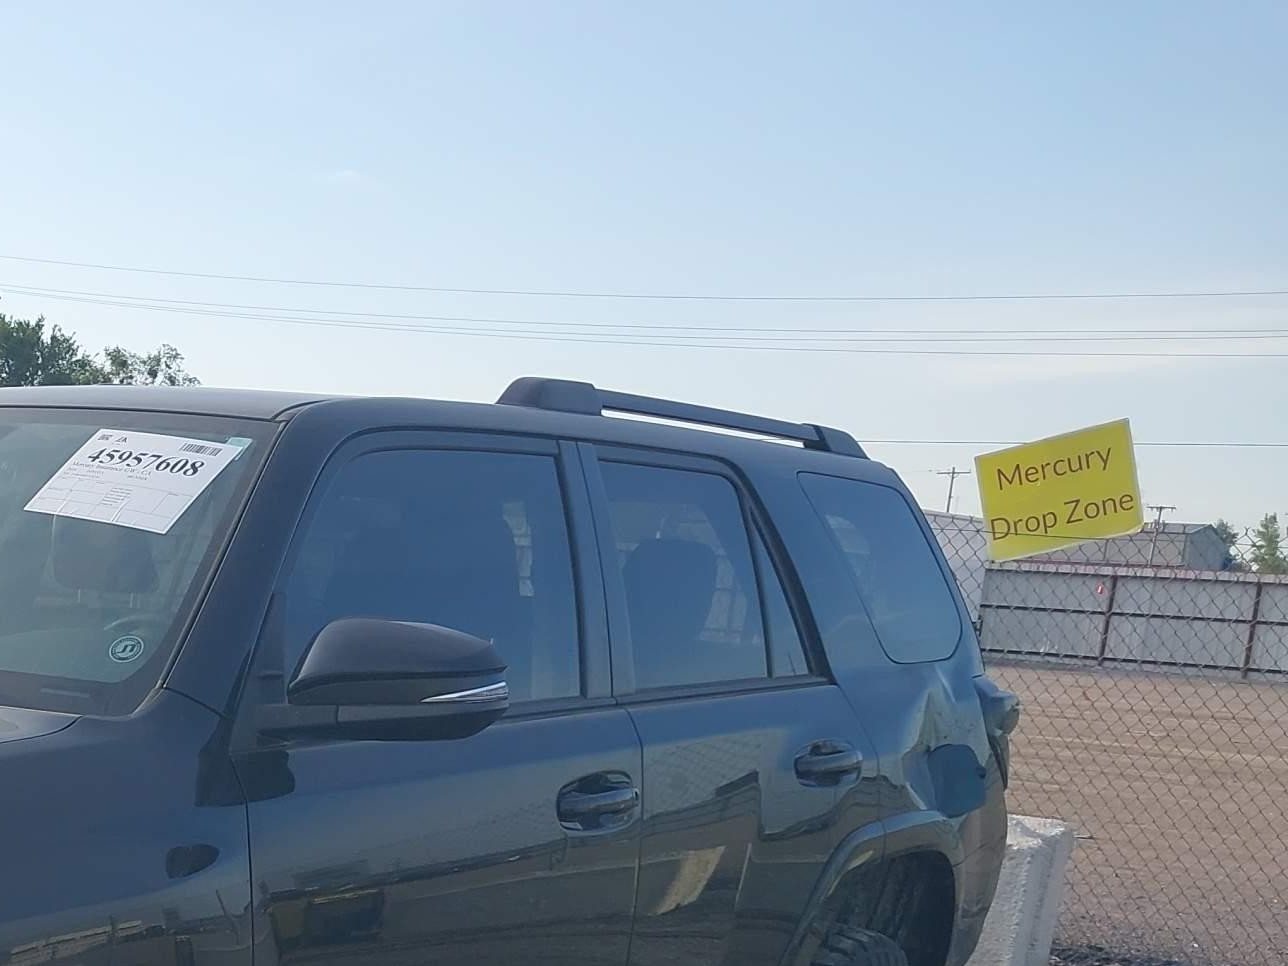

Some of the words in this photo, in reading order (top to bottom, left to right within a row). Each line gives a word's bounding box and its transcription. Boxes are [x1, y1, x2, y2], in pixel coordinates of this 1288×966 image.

[87, 447, 205, 477] 45957608
[996, 447, 1112, 491] Mercury
[990, 510, 1058, 541] Drop
[1063, 493, 1135, 525] Zone
